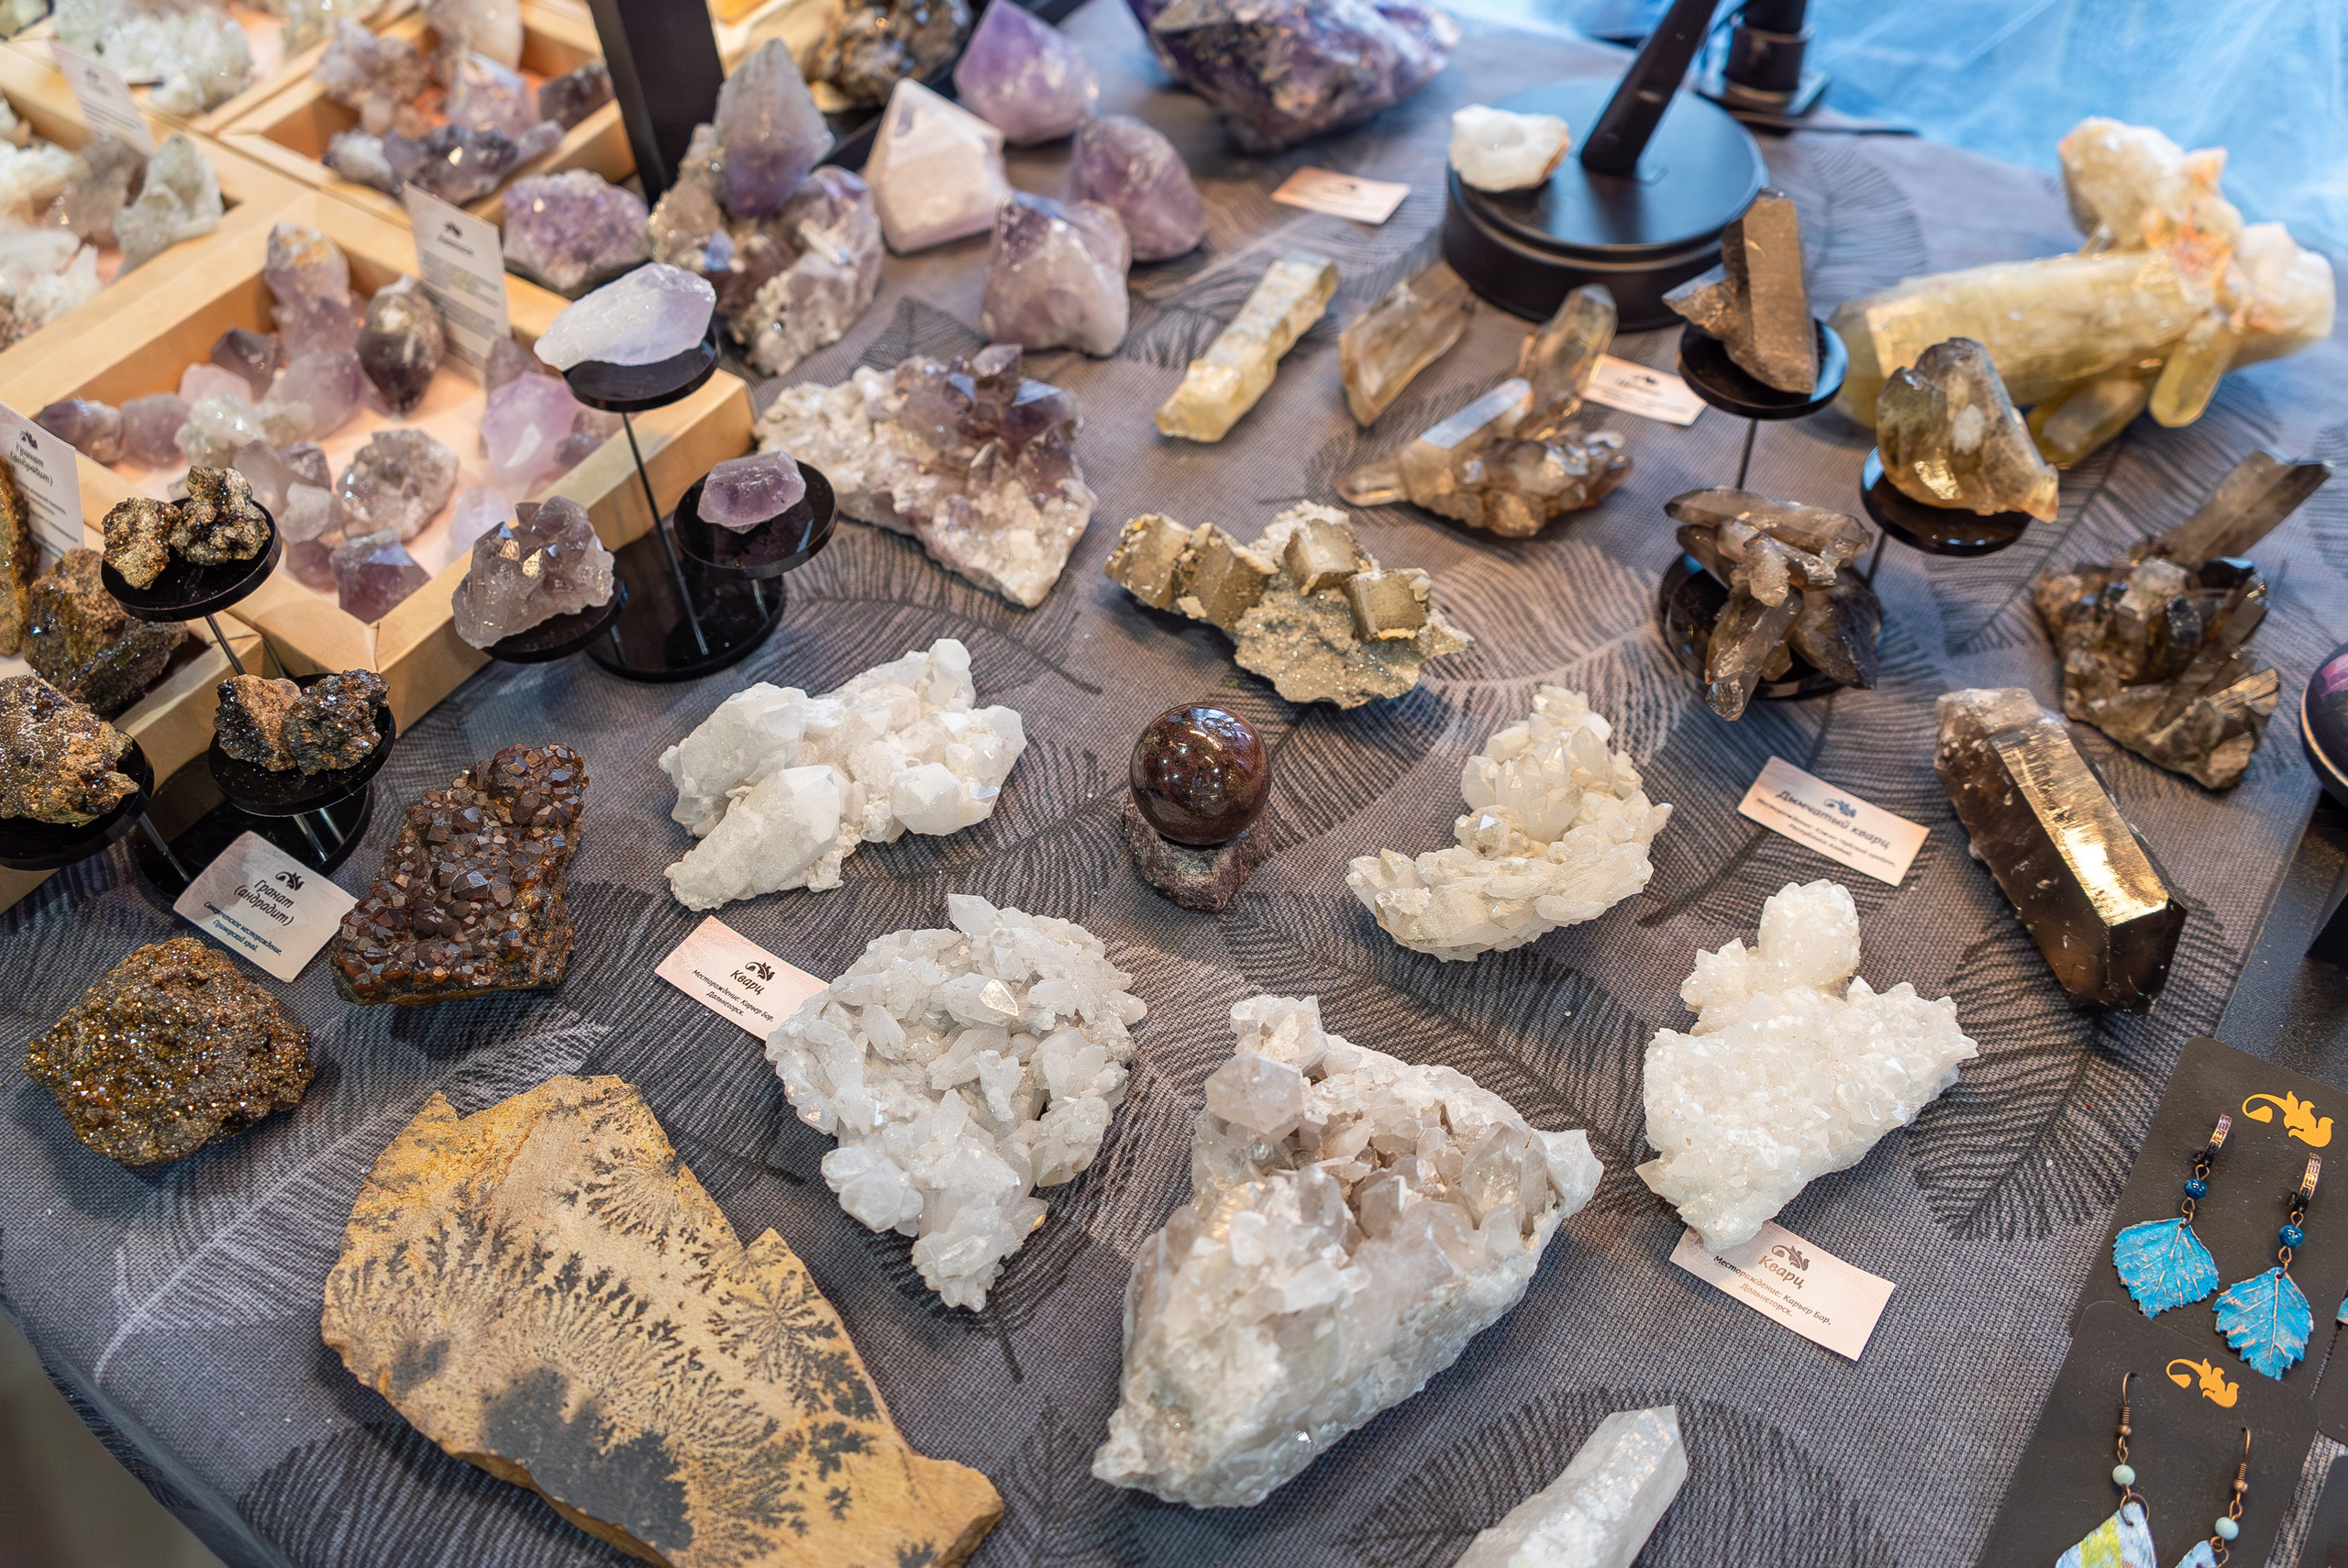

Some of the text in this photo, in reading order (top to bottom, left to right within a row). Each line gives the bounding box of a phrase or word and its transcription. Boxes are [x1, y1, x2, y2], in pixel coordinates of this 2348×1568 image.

[1775, 790, 1890, 850] Дымчатый кварц
[234, 885, 294, 926] (андрадит)
[254, 879, 294, 909] Гранат
[213, 919, 246, 943] Приморский
[692, 968, 774, 1022] Месторождение: Карьер Бор,
[730, 969, 766, 996] Кварц
[705, 990, 744, 1017] Дальнегорск.
[1713, 1254, 1832, 1326] Месторождение: Карьер Бор,
[1757, 1254, 1805, 1290] Кварц
[1739, 1282, 1793, 1318] Дальнегорск.
